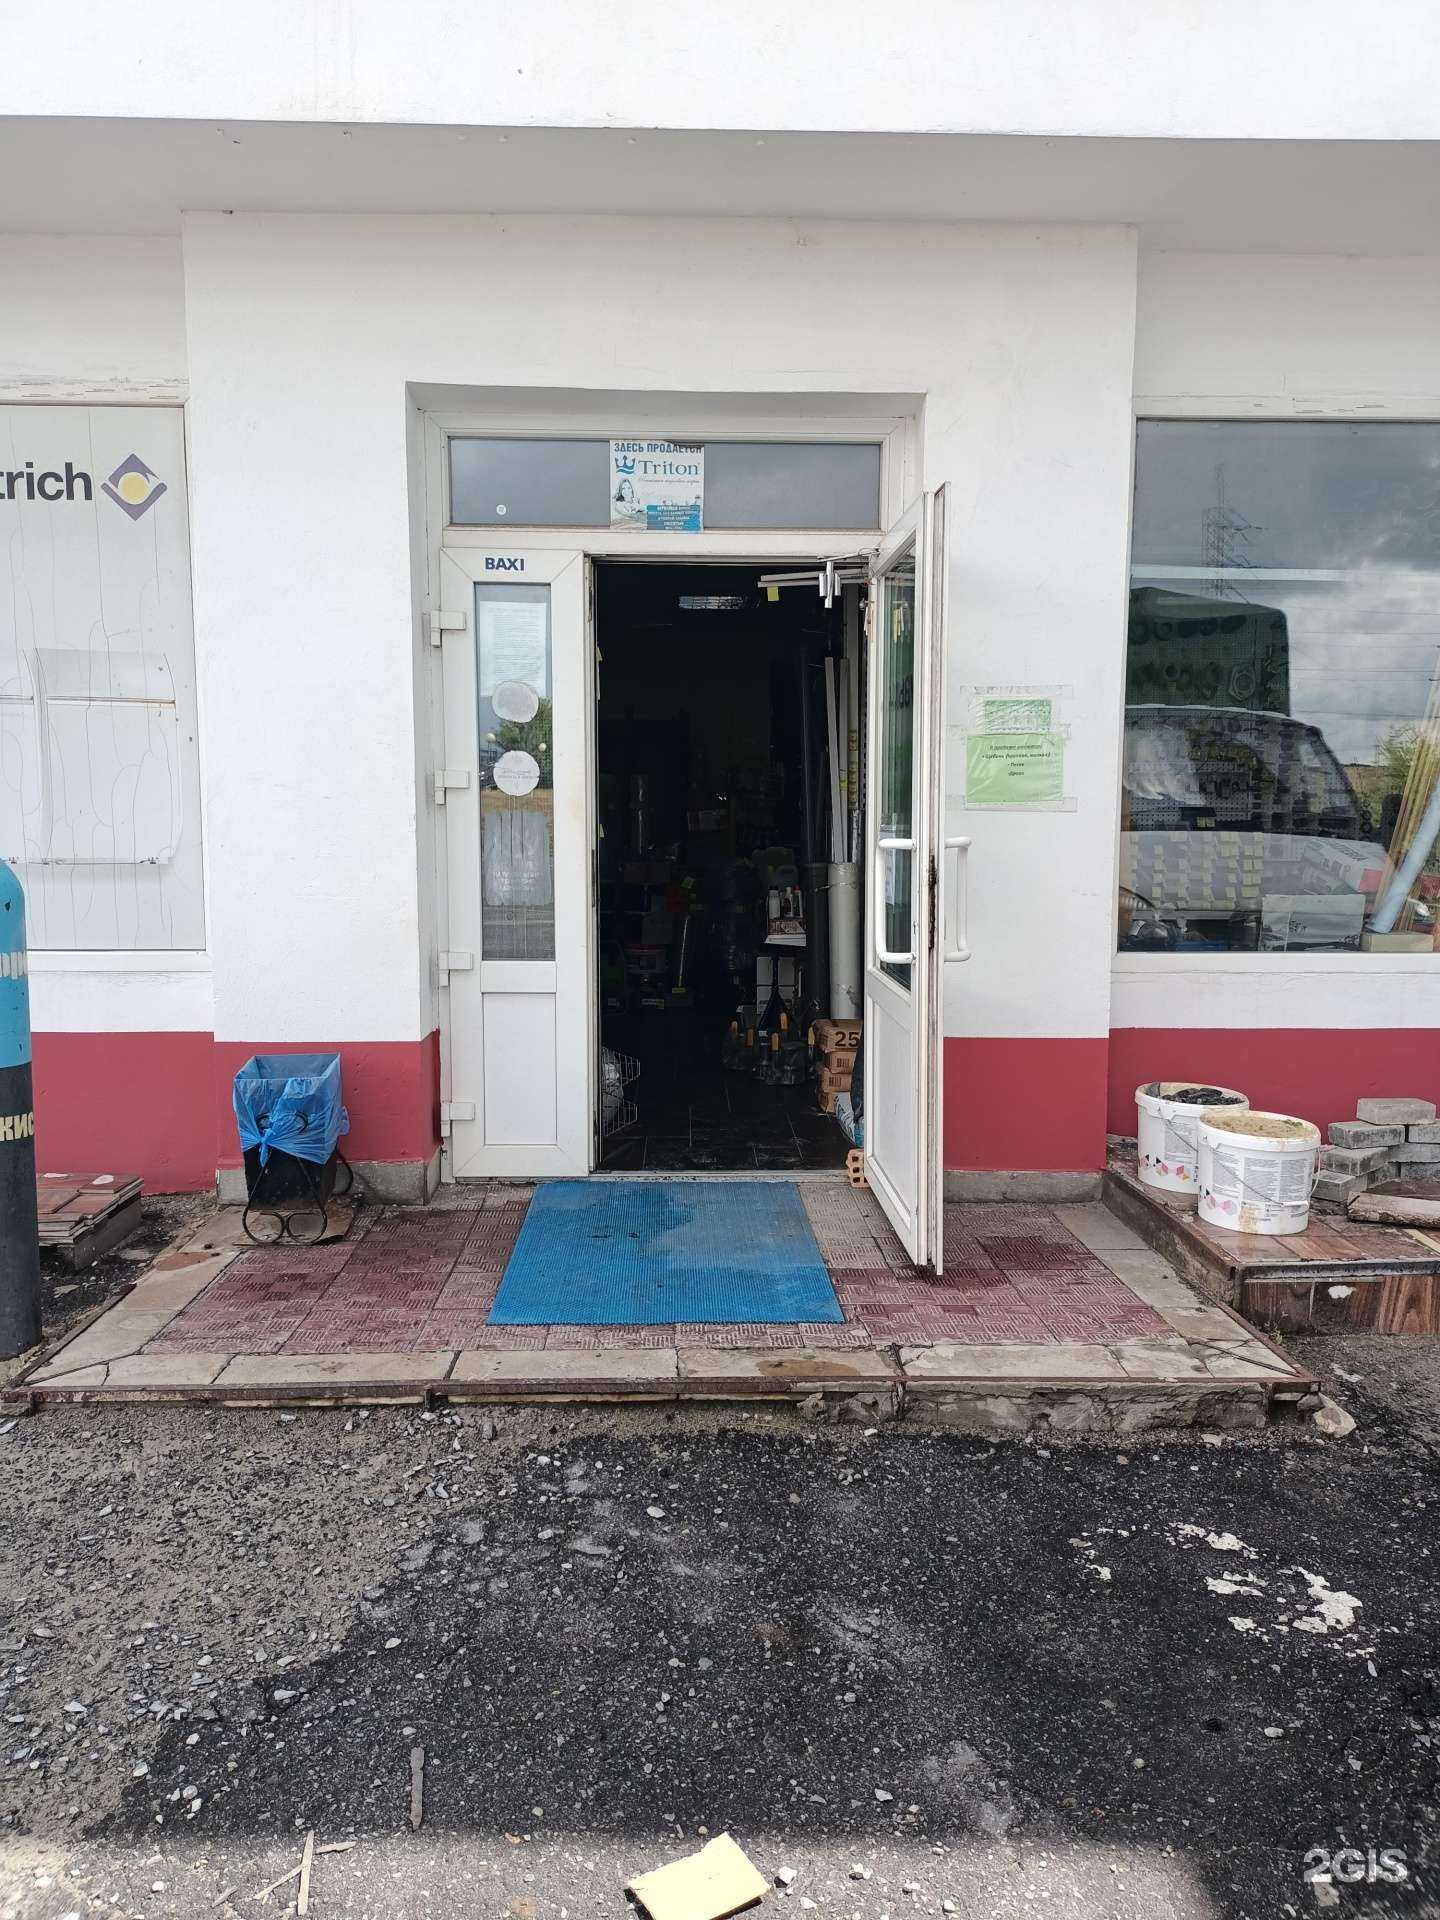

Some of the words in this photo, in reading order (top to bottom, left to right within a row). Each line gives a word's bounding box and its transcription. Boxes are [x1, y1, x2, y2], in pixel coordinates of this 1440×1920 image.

[614, 442, 644, 453] ЗДЕСЬ
[638, 460, 699, 475] Triton
[485, 557, 525, 571] BAXI
[834, 1031, 860, 1047] 25
